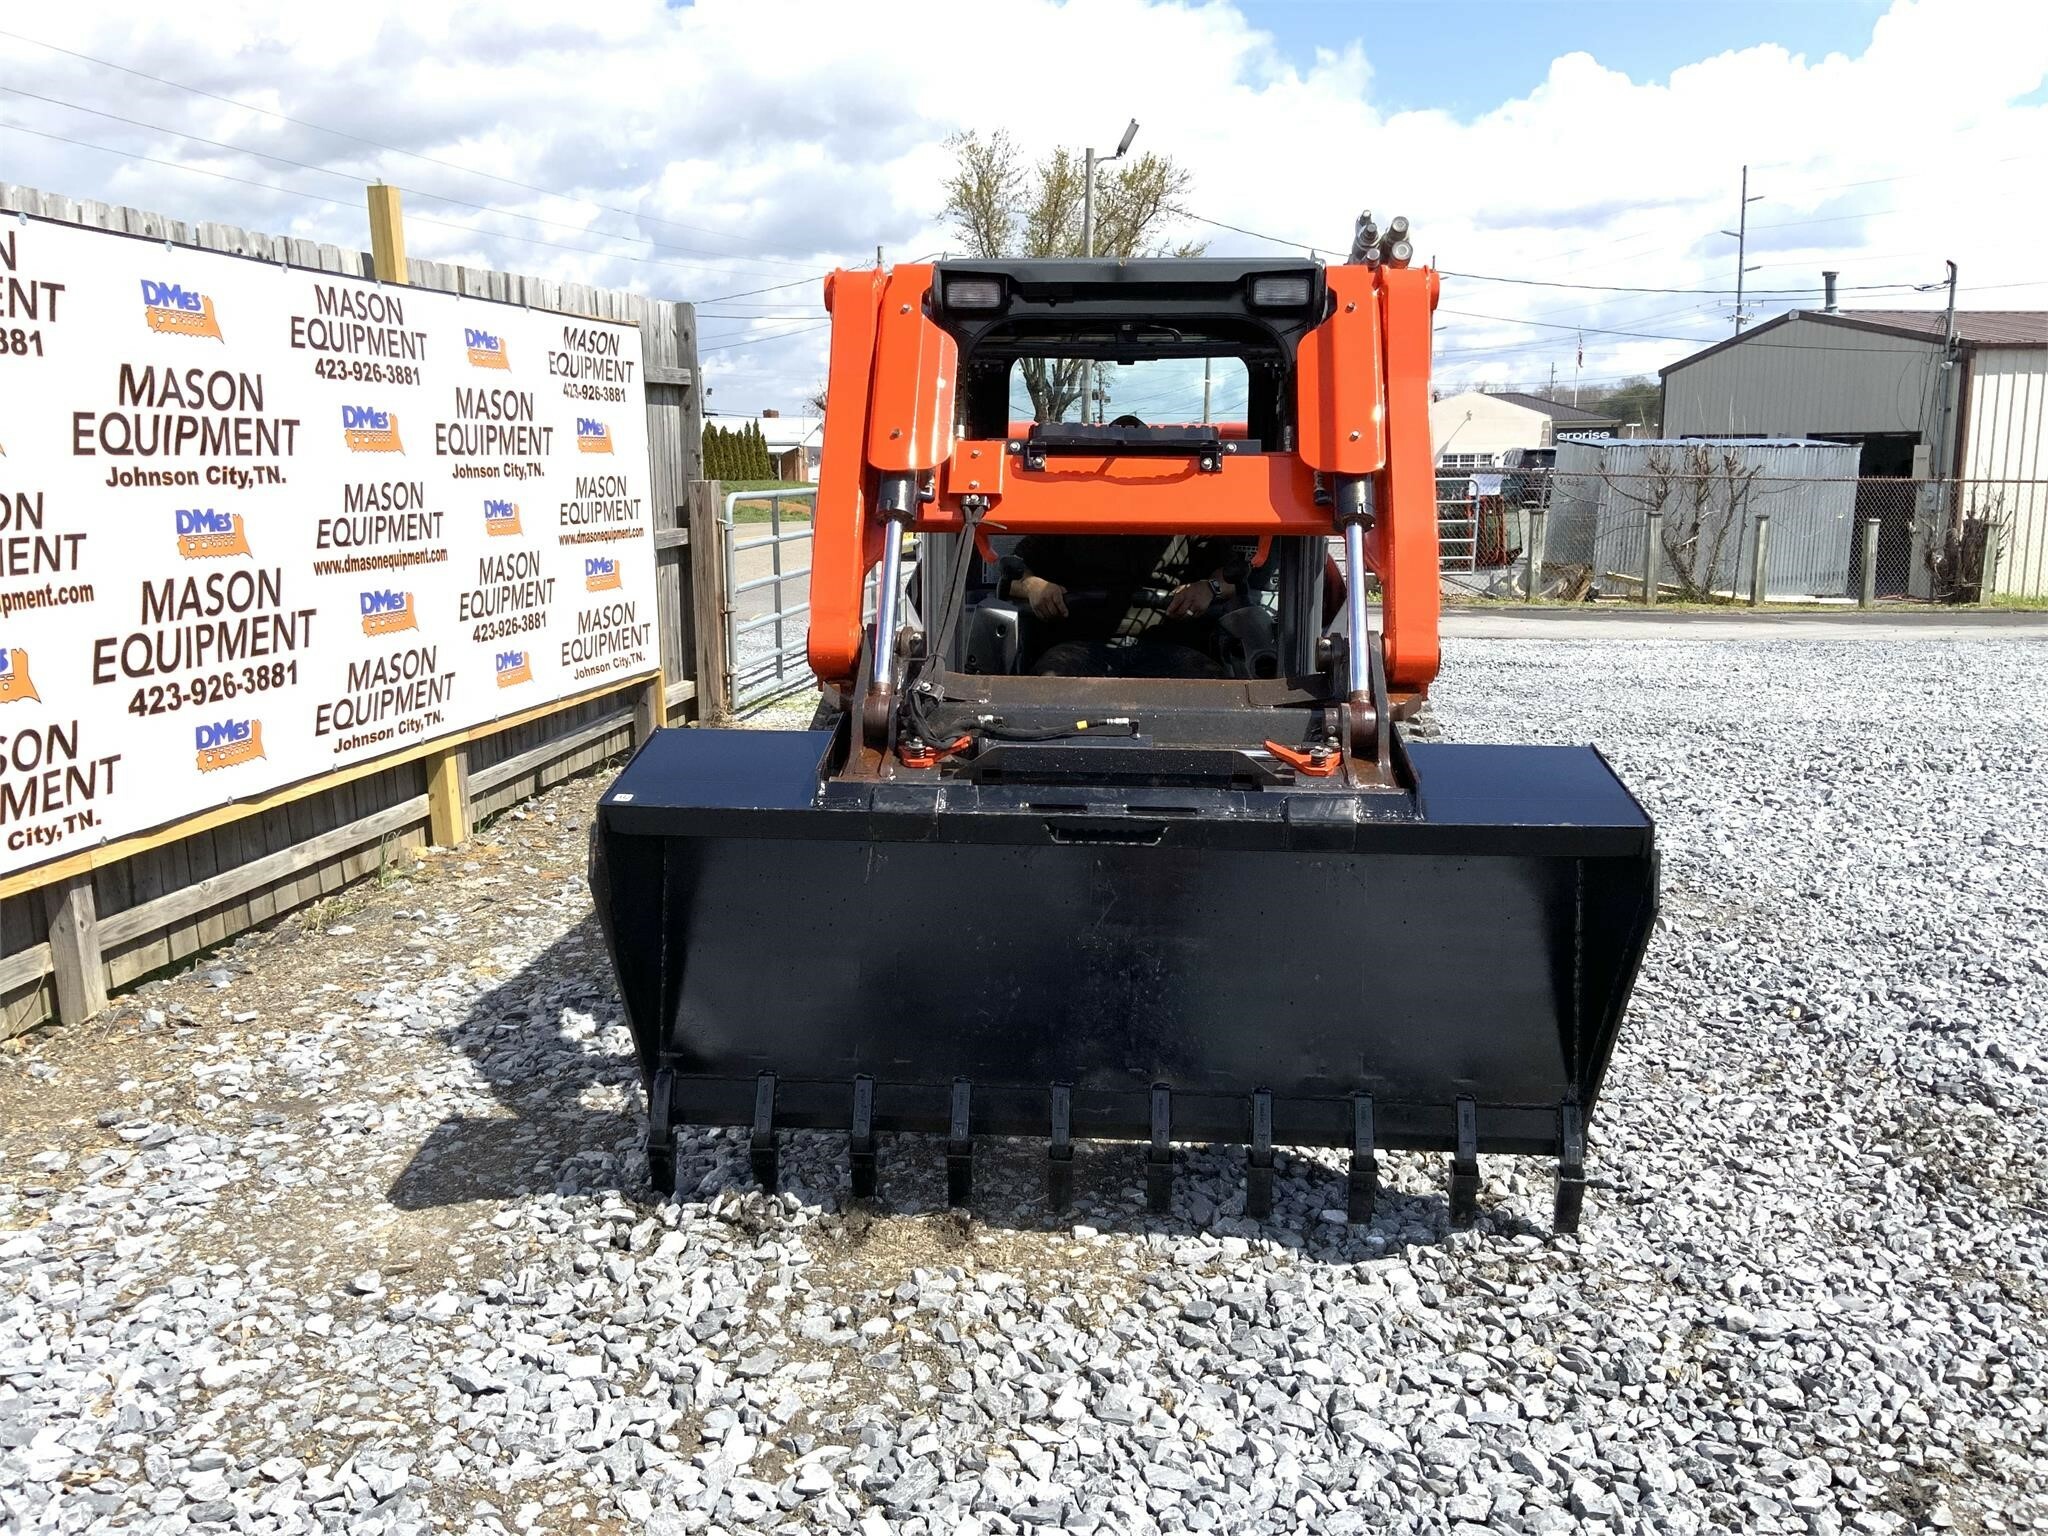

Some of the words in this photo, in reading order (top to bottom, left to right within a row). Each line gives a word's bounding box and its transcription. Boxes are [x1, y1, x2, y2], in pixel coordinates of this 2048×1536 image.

[0, 277, 65, 322] NT
[314, 284, 403, 325] MASON
[291, 316, 427, 360] EQUIPMENT
[564, 327, 619, 356] MASON
[315, 358, 421, 386] 423-926-3881
[549, 351, 634, 382] EQUIPMENT
[119, 363, 264, 412] MASON
[456, 387, 534, 421] MASON
[563, 382, 626, 402] 423-926-3881
[73, 411, 300, 456] EQUIPMENT
[436, 423, 553, 456] EQUIPMENT
[106, 467, 199, 487] Johnson
[452, 464, 500, 479] Johnson
[576, 476, 627, 499] MASON
[344, 482, 424, 512] MASON
[560, 499, 641, 526] EQUIPMENT
[317, 512, 443, 549] EQUIPMENT
[0, 534, 86, 577] ENT
[314, 548, 448, 576] www.dmasonequipment.com
[479, 551, 540, 586] MASON
[0, 583, 94, 618] pment.com
[142, 568, 282, 625] MASON
[460, 578, 555, 621] EQUIPMENT
[473, 611, 547, 643] 423-926-3881
[578, 601, 636, 634] MASON
[93, 609, 316, 685] EQUIPMENT
[562, 623, 651, 666] EQUIPMENT
[348, 646, 437, 693] MASON
[574, 663, 611, 680] Johnson
[129, 660, 297, 717] 423-926-3881
[315, 672, 455, 736] EQUIPMENT
[334, 728, 394, 754] Johnson
